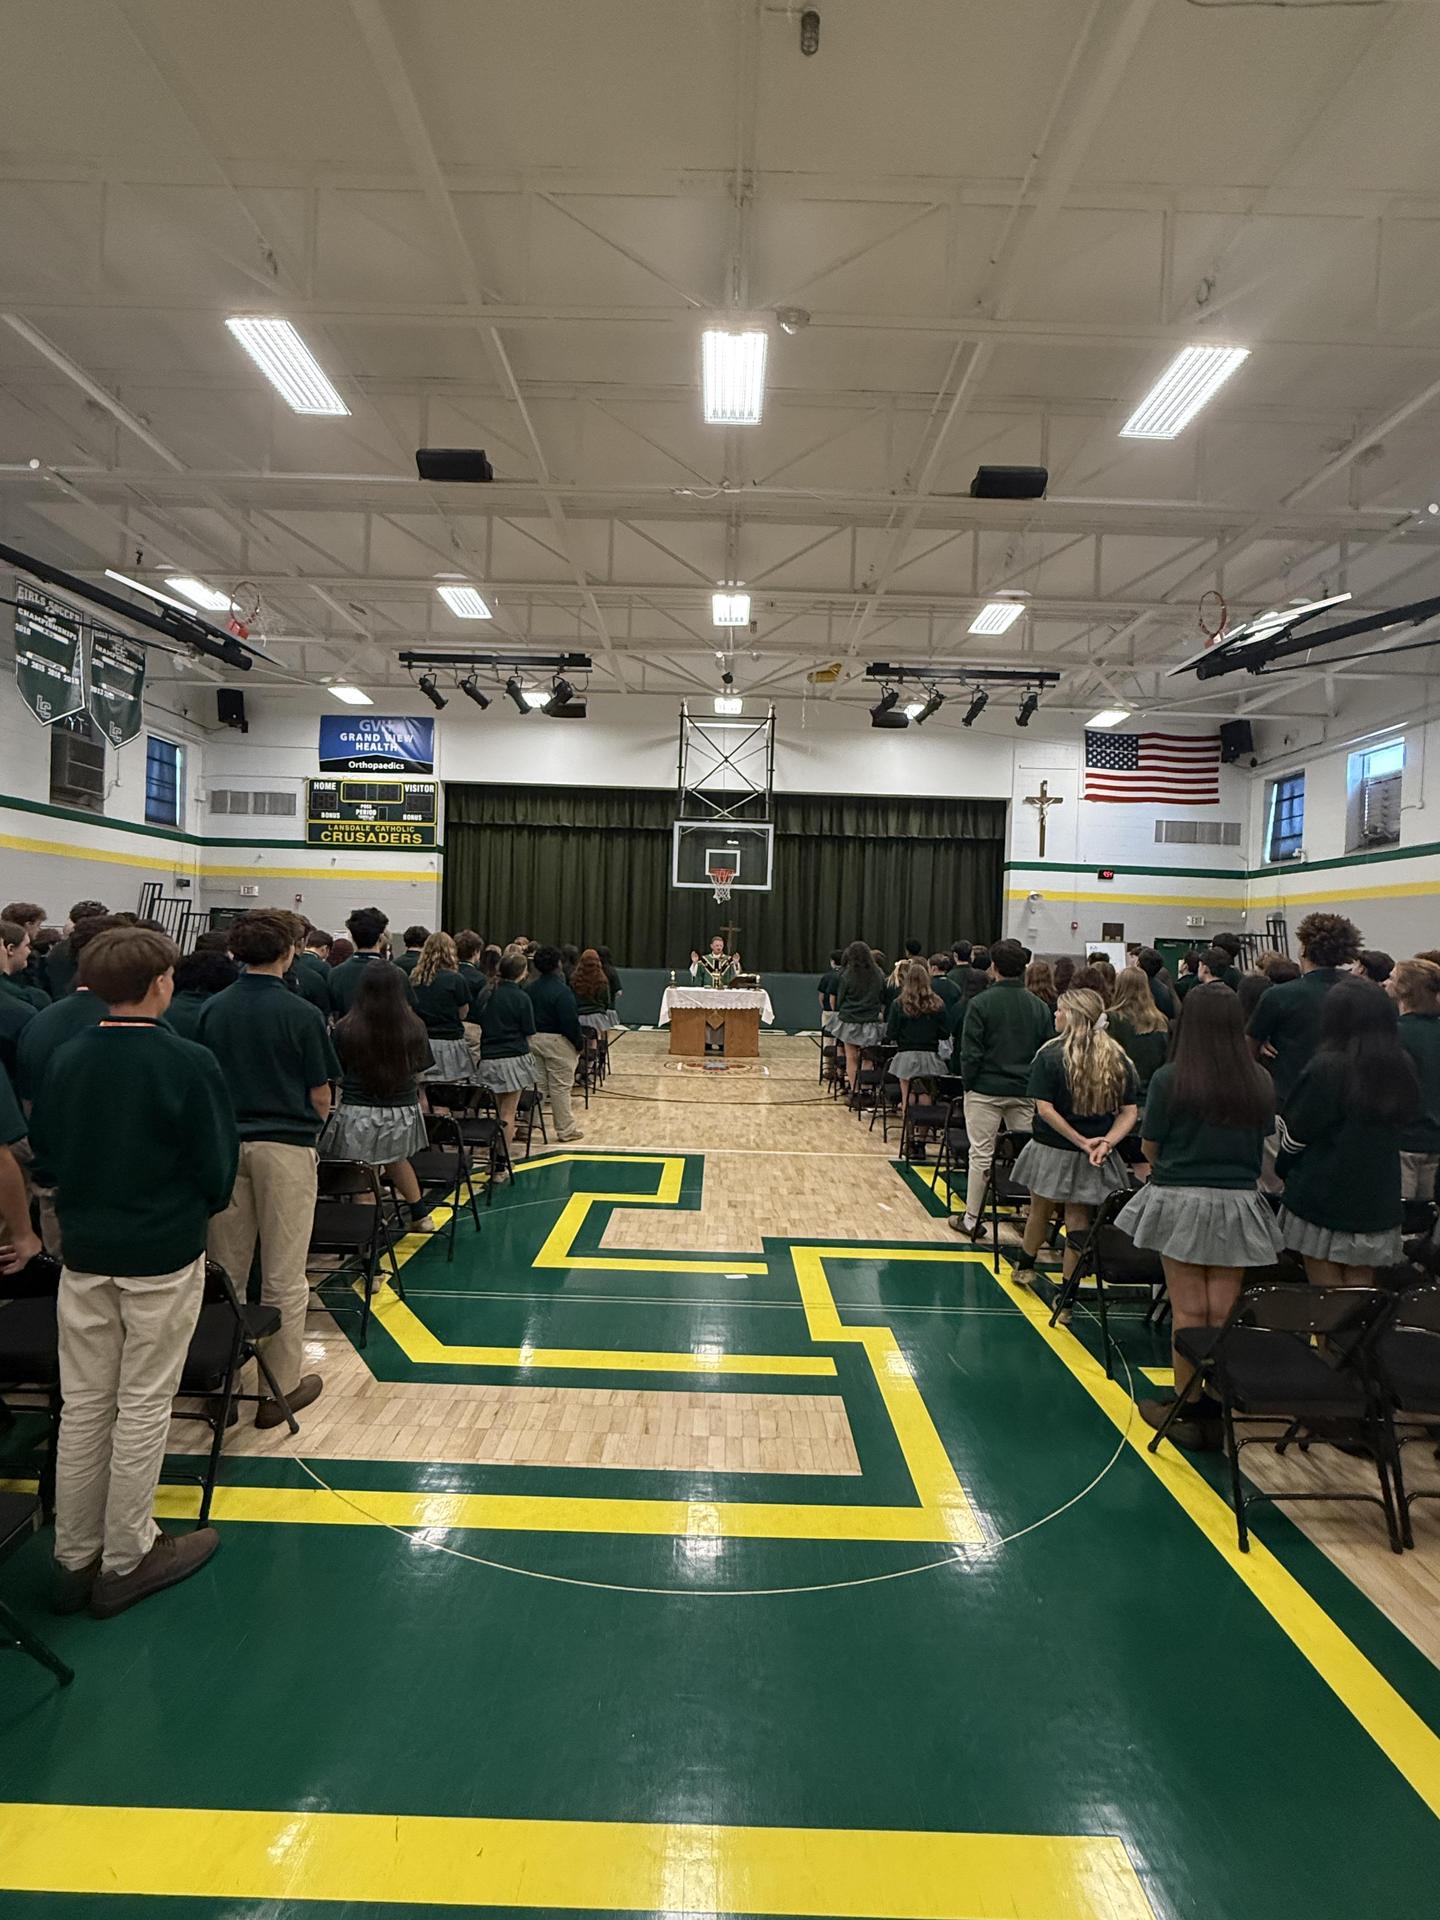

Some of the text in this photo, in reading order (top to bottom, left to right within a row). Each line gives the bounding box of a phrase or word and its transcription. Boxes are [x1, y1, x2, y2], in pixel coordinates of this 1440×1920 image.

[18, 585, 46, 606] GIRLS
[18, 607, 77, 641] CHAMPIONSHIPS
[340, 732, 381, 742] GRAND
[355, 742, 398, 752] HEALTH
[348, 761, 405, 771] Orthopaedics
[313, 781, 337, 791] HOME
[404, 784, 435, 793] VISITOR
[355, 808, 377, 816] PERIOD
[321, 831, 422, 844] CRUSADERS
